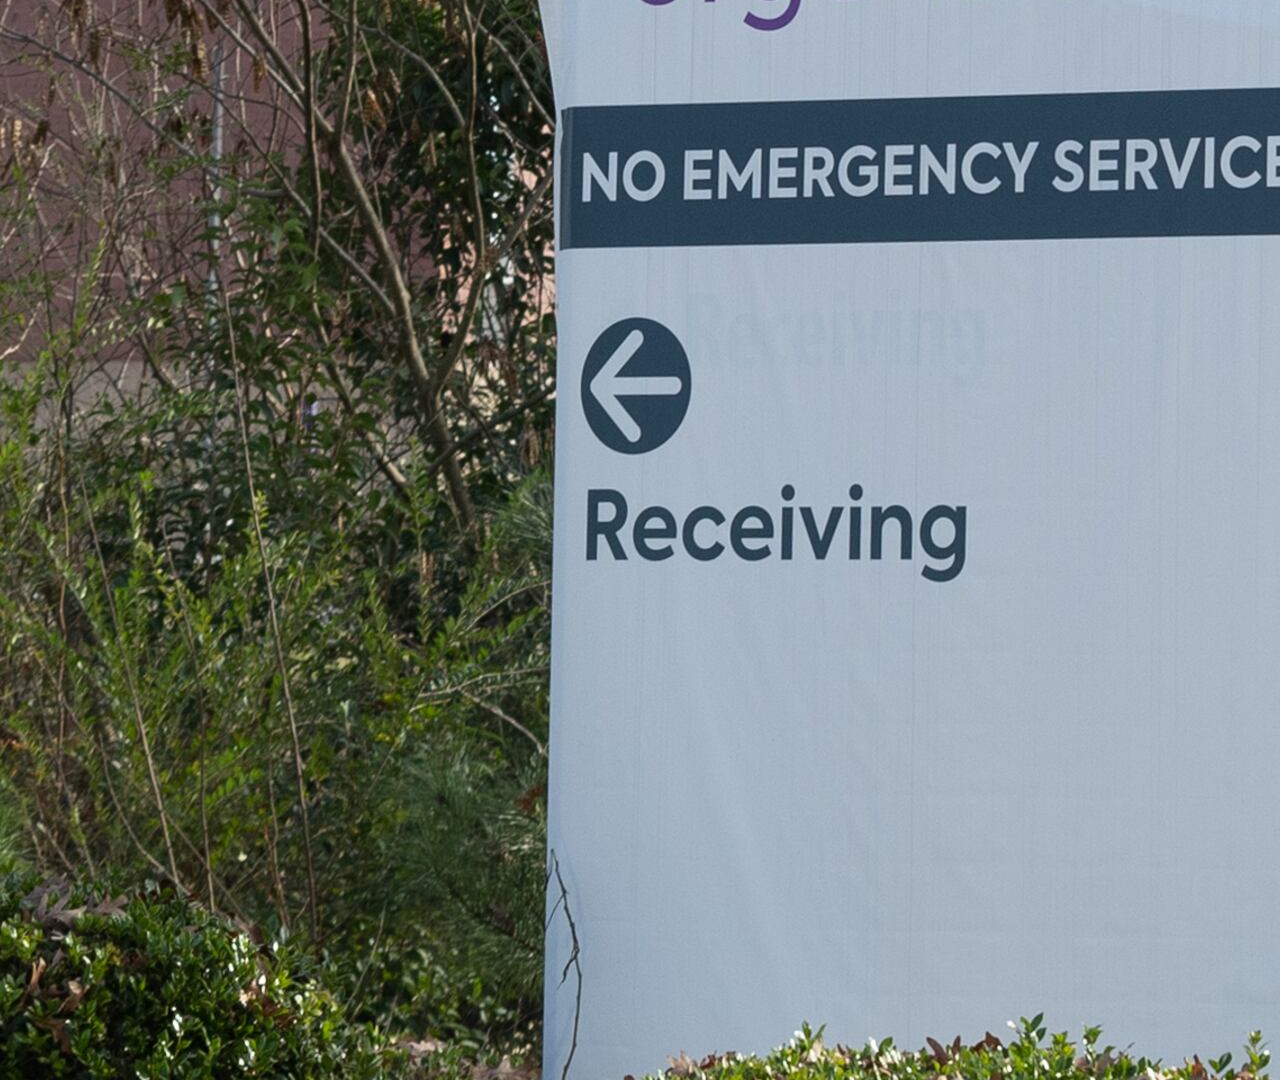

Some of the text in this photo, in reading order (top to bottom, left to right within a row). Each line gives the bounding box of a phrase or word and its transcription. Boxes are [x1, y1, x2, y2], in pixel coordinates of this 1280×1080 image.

[581, 150, 666, 203] NO
[683, 141, 1040, 201] EMERGENCY
[585, 483, 968, 583] Receiving
